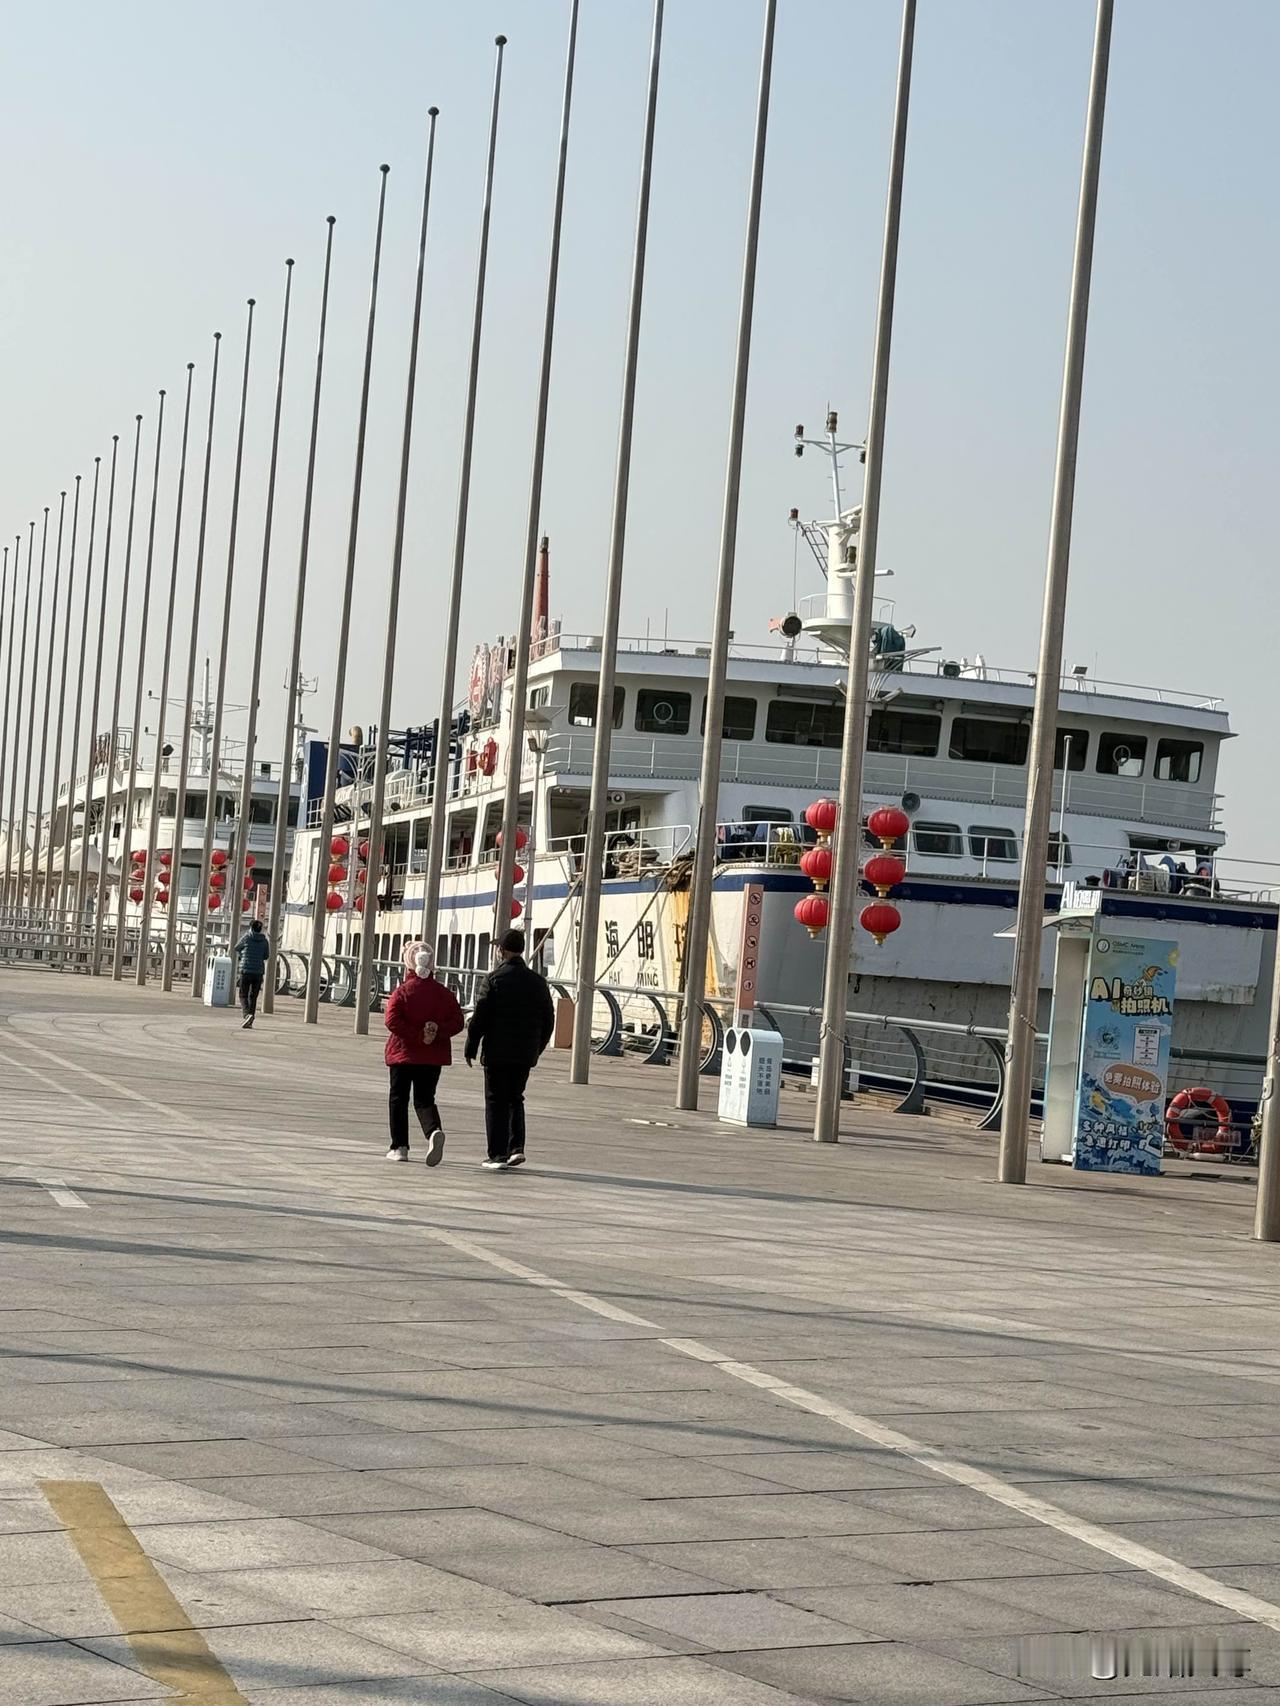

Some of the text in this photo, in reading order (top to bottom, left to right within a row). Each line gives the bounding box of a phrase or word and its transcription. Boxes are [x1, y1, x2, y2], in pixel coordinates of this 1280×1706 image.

[637, 972, 659, 987] MING
[1120, 997, 1169, 1014] 拍照机
[1104, 1072, 1161, 1094] 免费拍照体验
